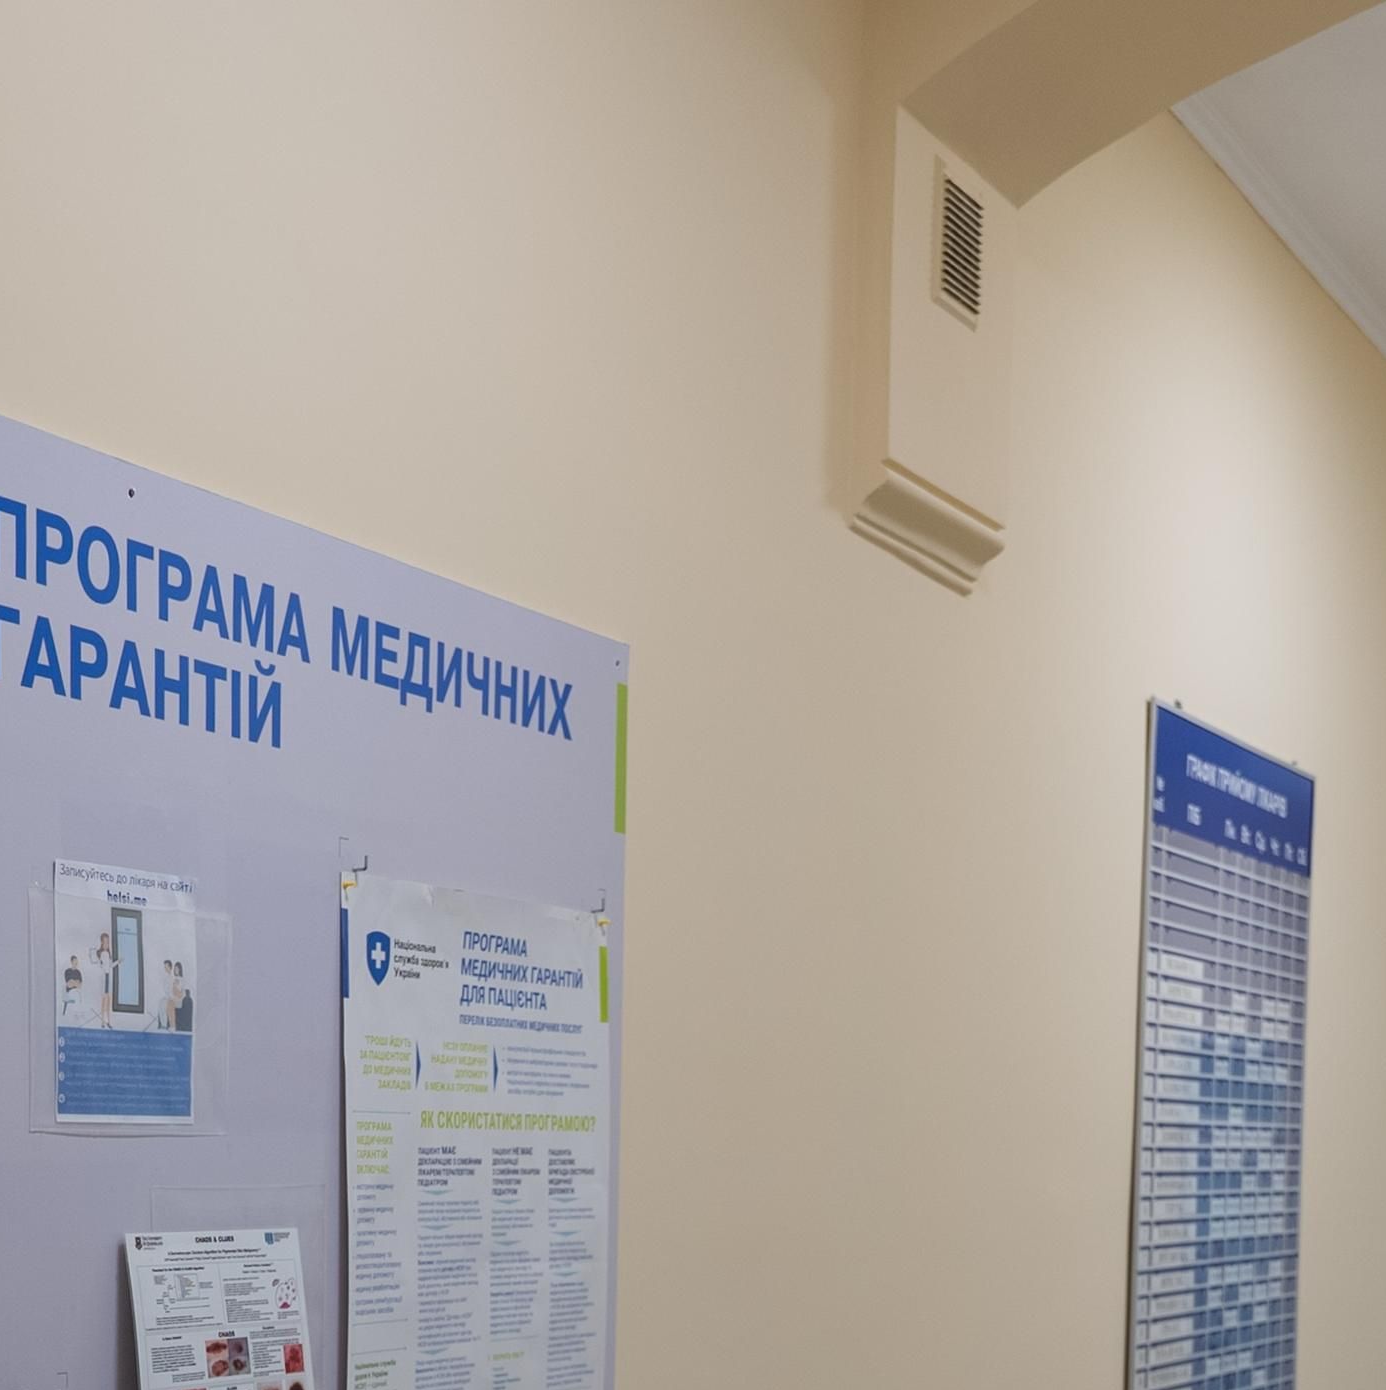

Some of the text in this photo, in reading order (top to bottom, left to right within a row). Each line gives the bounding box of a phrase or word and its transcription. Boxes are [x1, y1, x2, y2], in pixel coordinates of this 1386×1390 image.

[331, 605, 573, 741] МЕДИЧНИХ
[59, 863, 115, 883] Записуйтесь
[116, 874, 128, 885] до
[128, 874, 156, 890] лікаря
[157, 879, 169, 890] на
[106, 889, 147, 907] helsi.me
[393, 938, 437, 955] Національна
[462, 930, 528, 958] ПРОГРАМА
[393, 953, 419, 967] служба
[393, 966, 421, 980] України
[460, 957, 584, 989] МЕДИЧНИХ ГАРАНТІЙ
[459, 984, 548, 1010] ДЛЯ ПАЦІЄНТА
[420, 1109, 596, 1132] ЯК СКОРИСТАТИСЯ ПРОГРАМОЮ?
